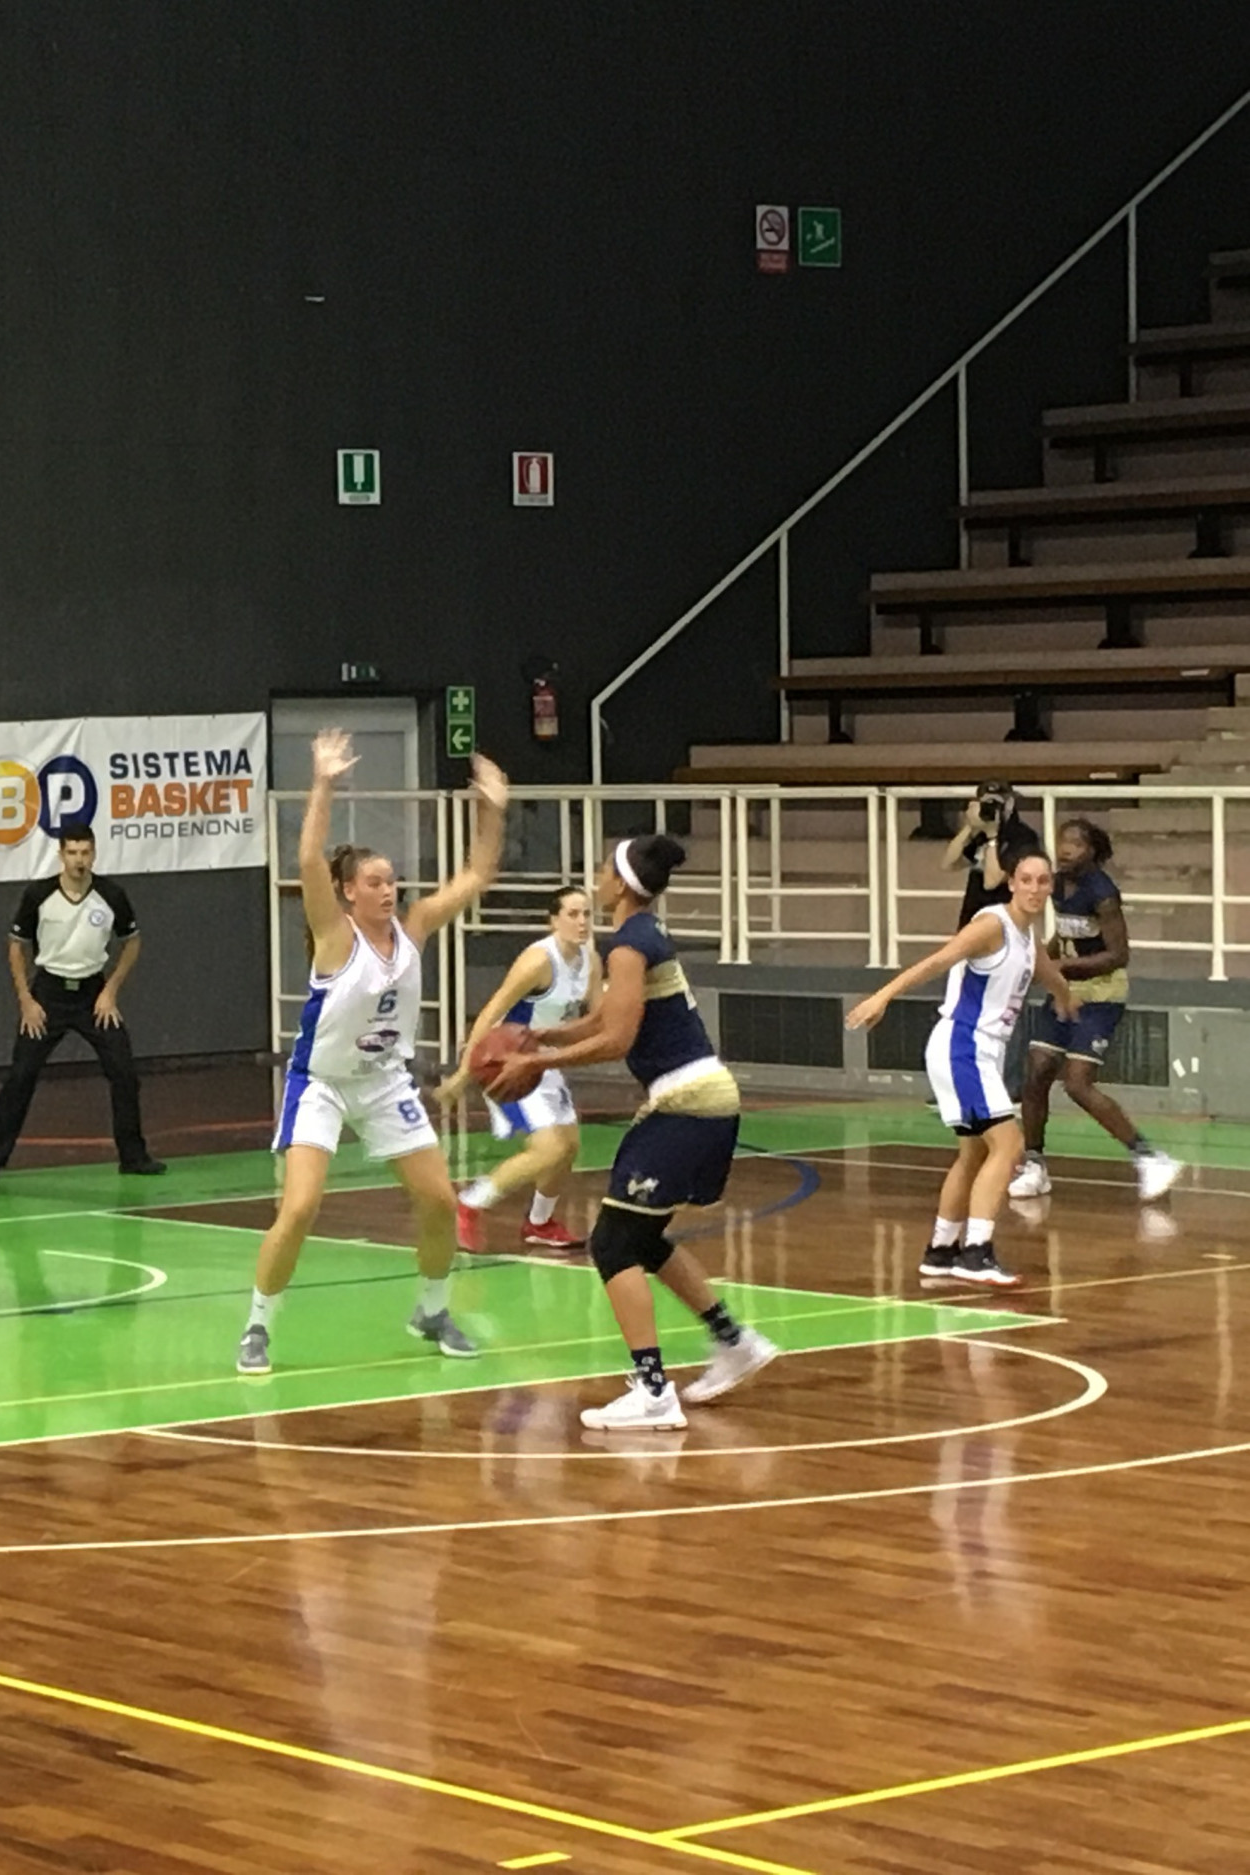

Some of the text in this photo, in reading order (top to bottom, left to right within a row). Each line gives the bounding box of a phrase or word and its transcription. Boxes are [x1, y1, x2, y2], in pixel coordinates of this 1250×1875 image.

[109, 748, 252, 780] SISTEMA
[110, 779, 254, 819] BASKET
[110, 818, 254, 840] PORDENONE
